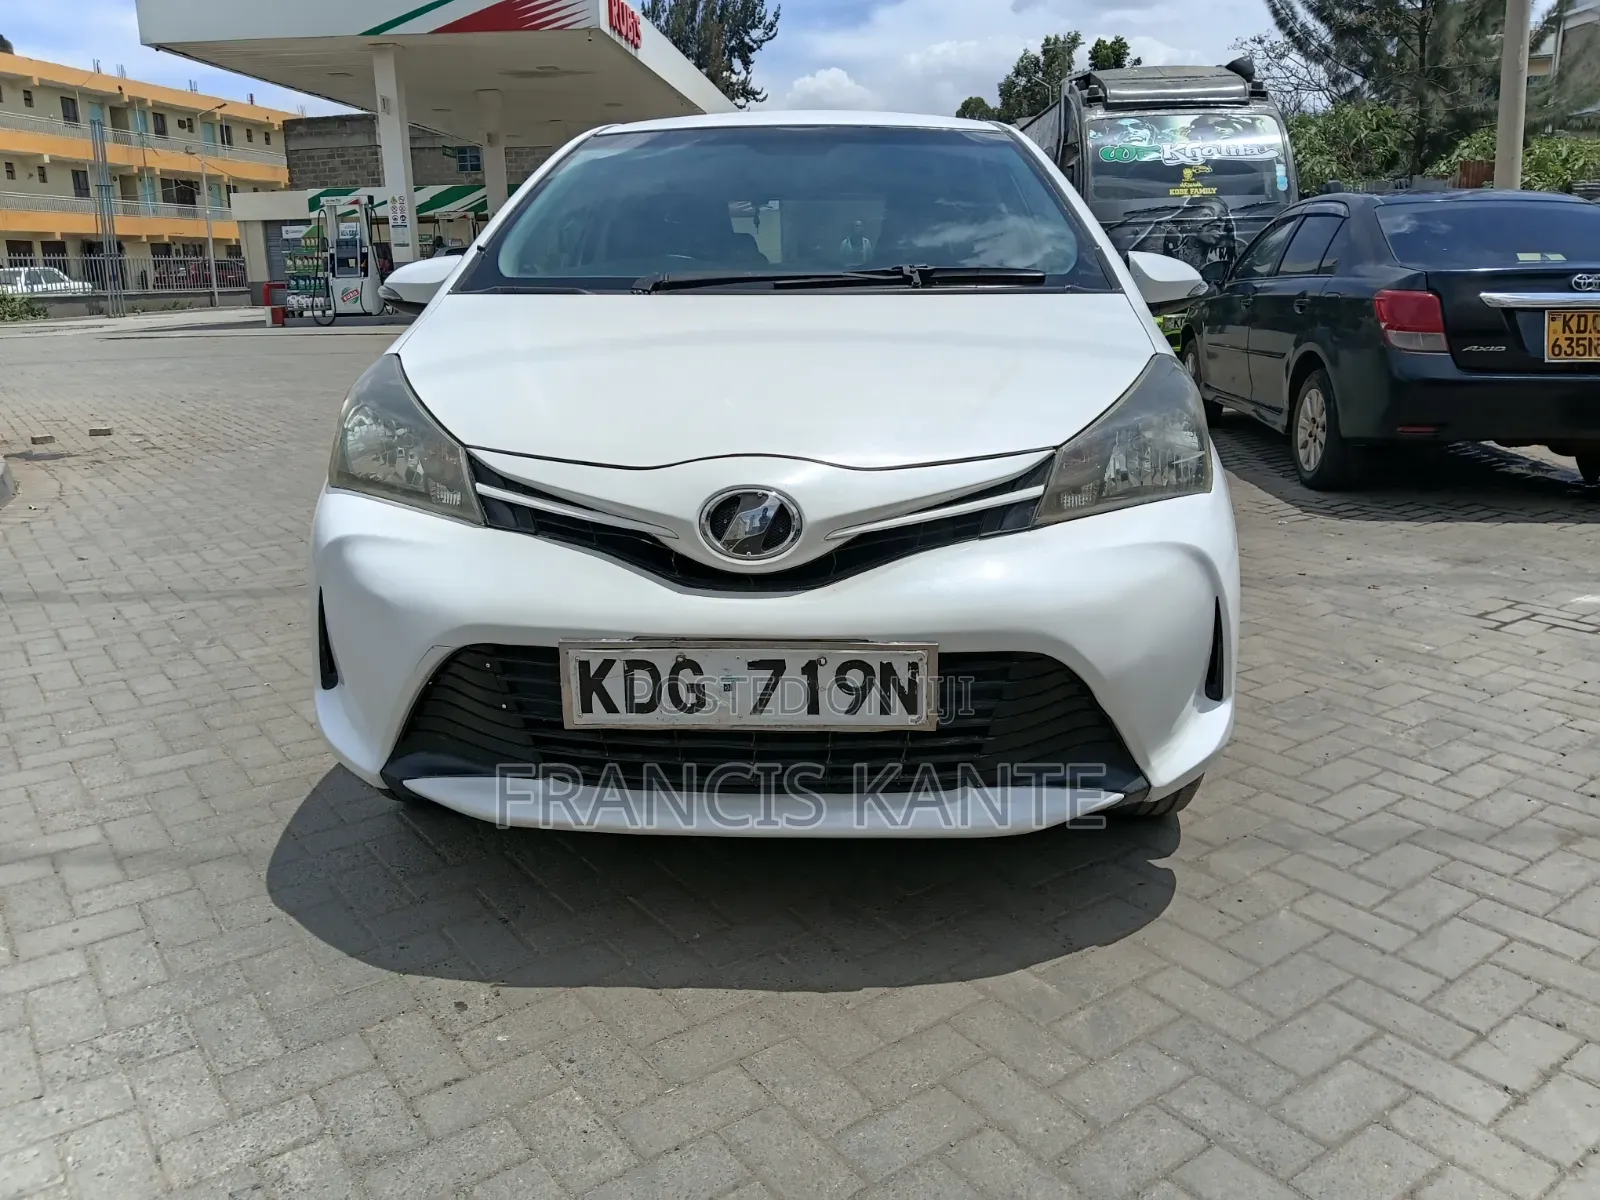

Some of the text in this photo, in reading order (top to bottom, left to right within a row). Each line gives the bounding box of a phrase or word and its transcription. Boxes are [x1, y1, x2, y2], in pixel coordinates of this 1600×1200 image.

[1190, 187, 1218, 195] FAMILY
[578, 658, 919, 716] KDG 719N
